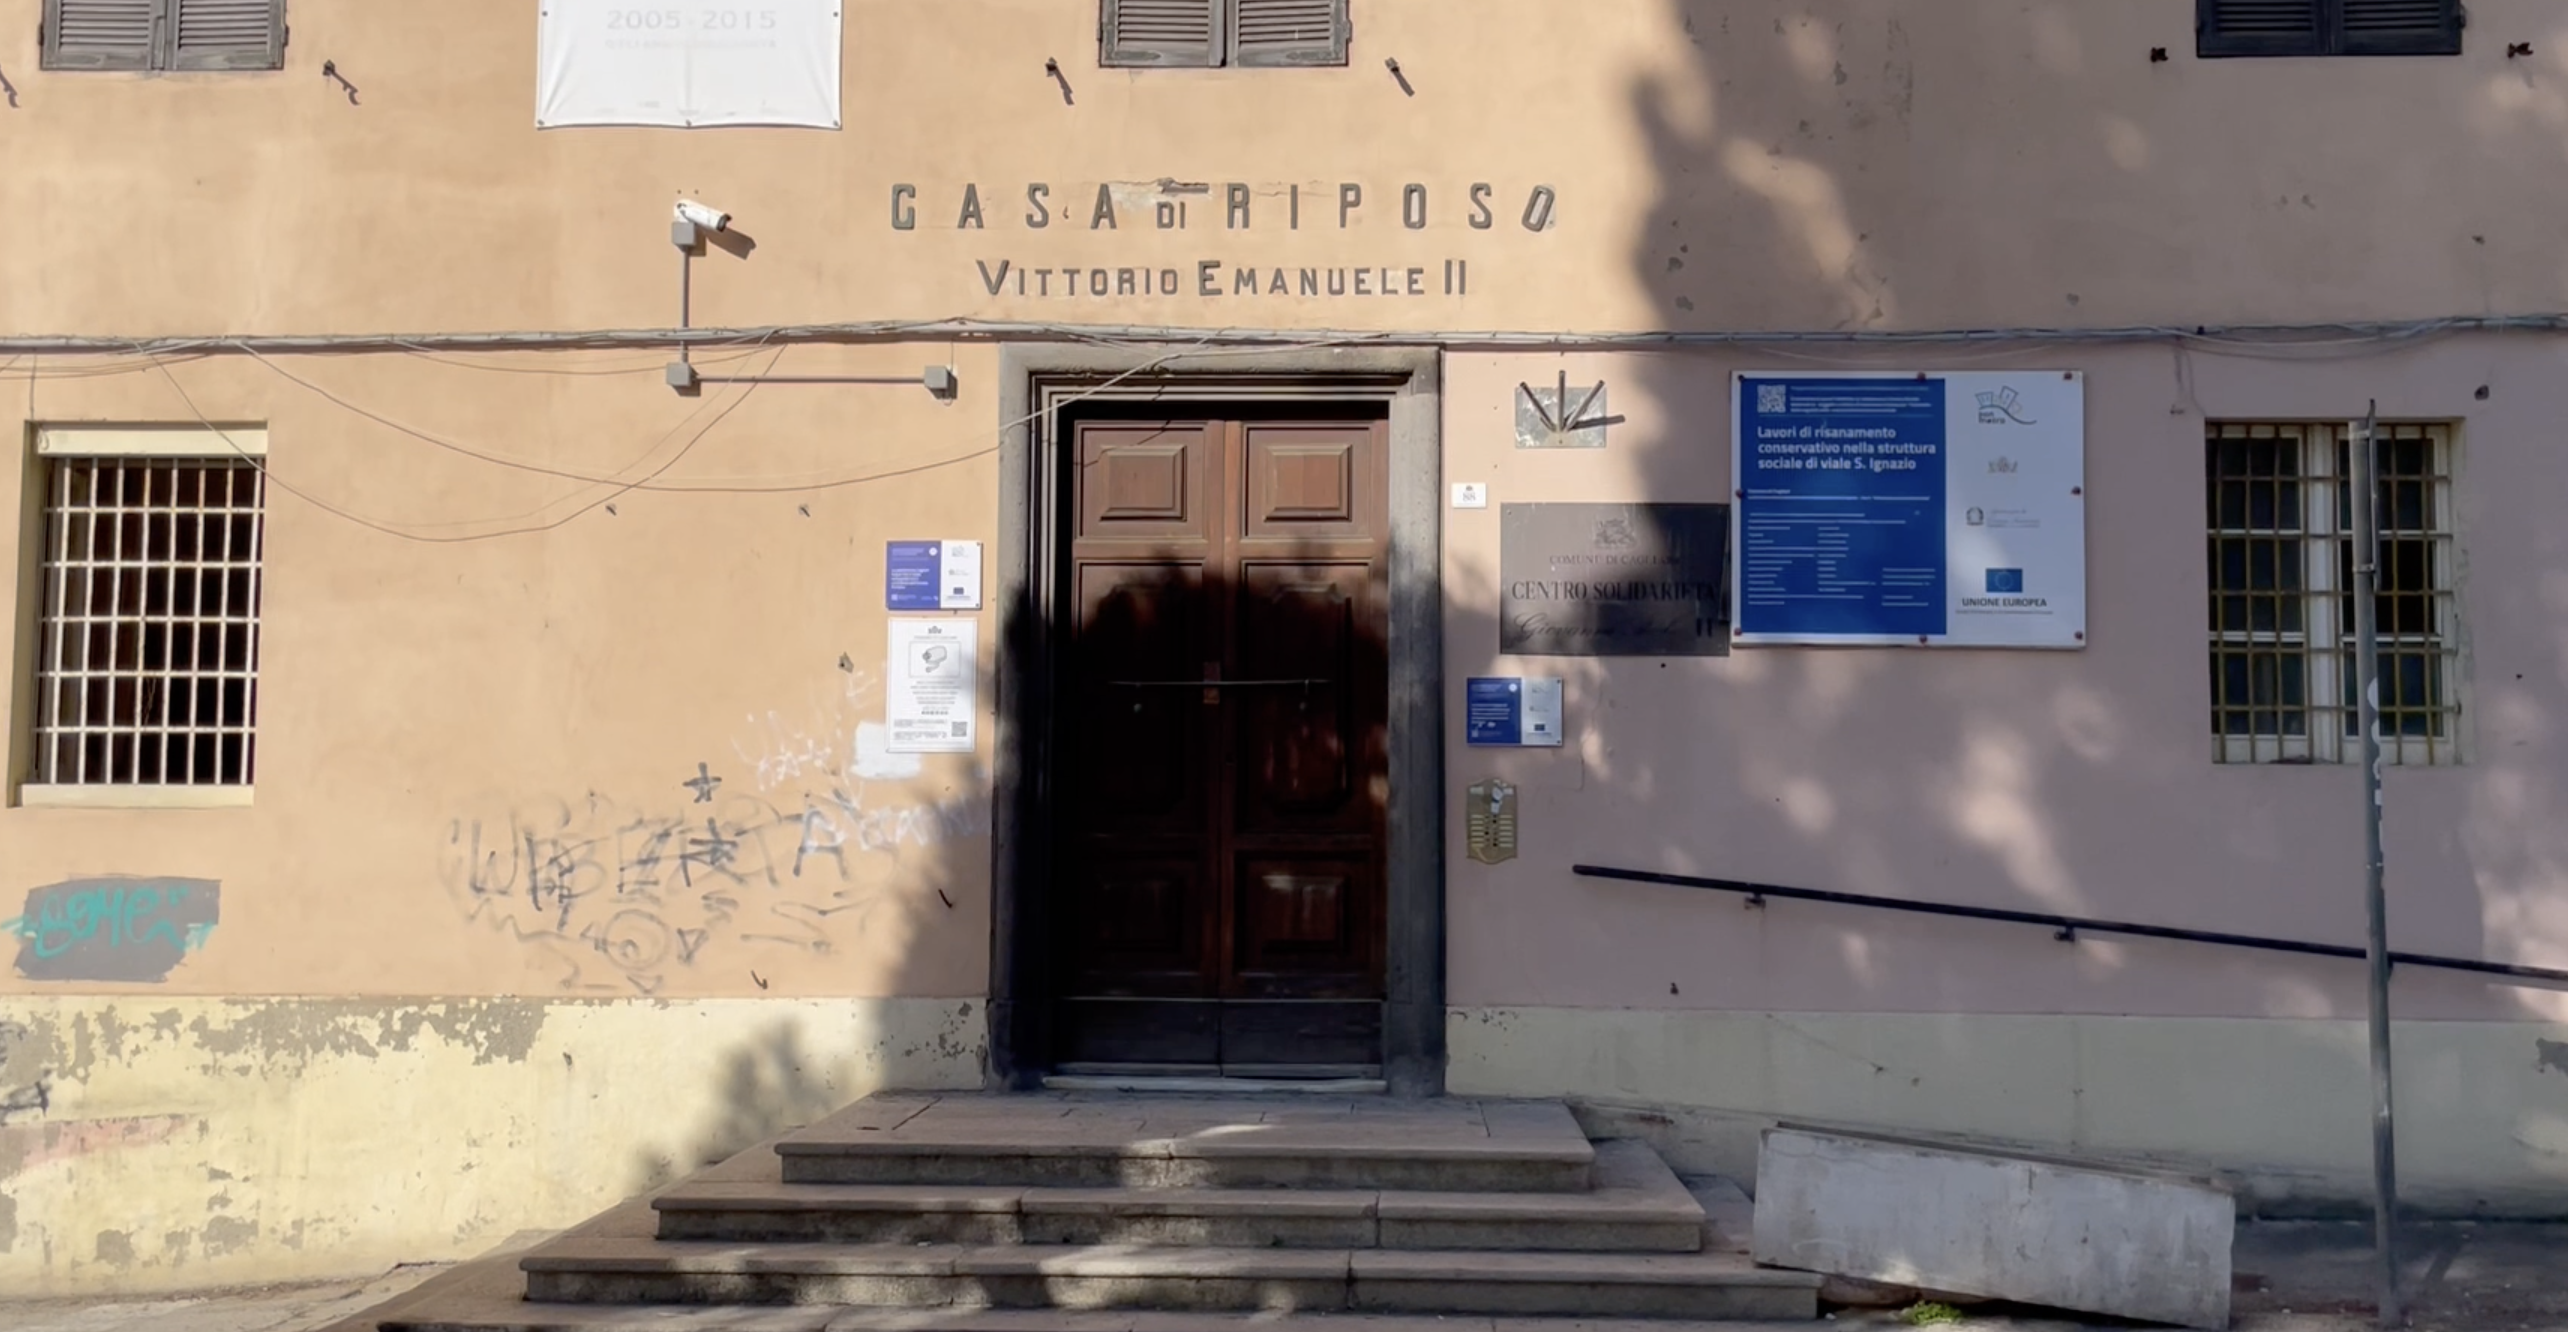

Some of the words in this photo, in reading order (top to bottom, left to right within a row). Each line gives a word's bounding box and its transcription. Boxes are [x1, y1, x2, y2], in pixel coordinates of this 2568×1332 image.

[607, 9, 681, 30] 2005
[701, 9, 777, 30] 2015
[891, 183, 1117, 231] CASA
[1156, 201, 1186, 230] DI
[1226, 182, 1556, 233] RIPOSO
[1444, 259, 1467, 295] II
[1757, 426, 1797, 439] Lavori
[1799, 426, 1812, 439] di
[1814, 427, 1896, 439] risanamento
[1757, 441, 1840, 454] conservativo
[1843, 442, 1874, 455] nella
[1877, 442, 1936, 455] struttura
[1757, 456, 1803, 469] sociale
[1805, 456, 1818, 470] di
[1820, 456, 1851, 470] viale
[1854, 457, 1866, 470] S.
[1869, 457, 1917, 473] Ignazio
[1549, 554, 1599, 565] COMUNE
[1606, 554, 1618, 565] DI
[1511, 581, 1587, 600] CENTRO
[1962, 597, 2000, 607] UNIONE
[2002, 597, 2048, 607] EUROPEA
